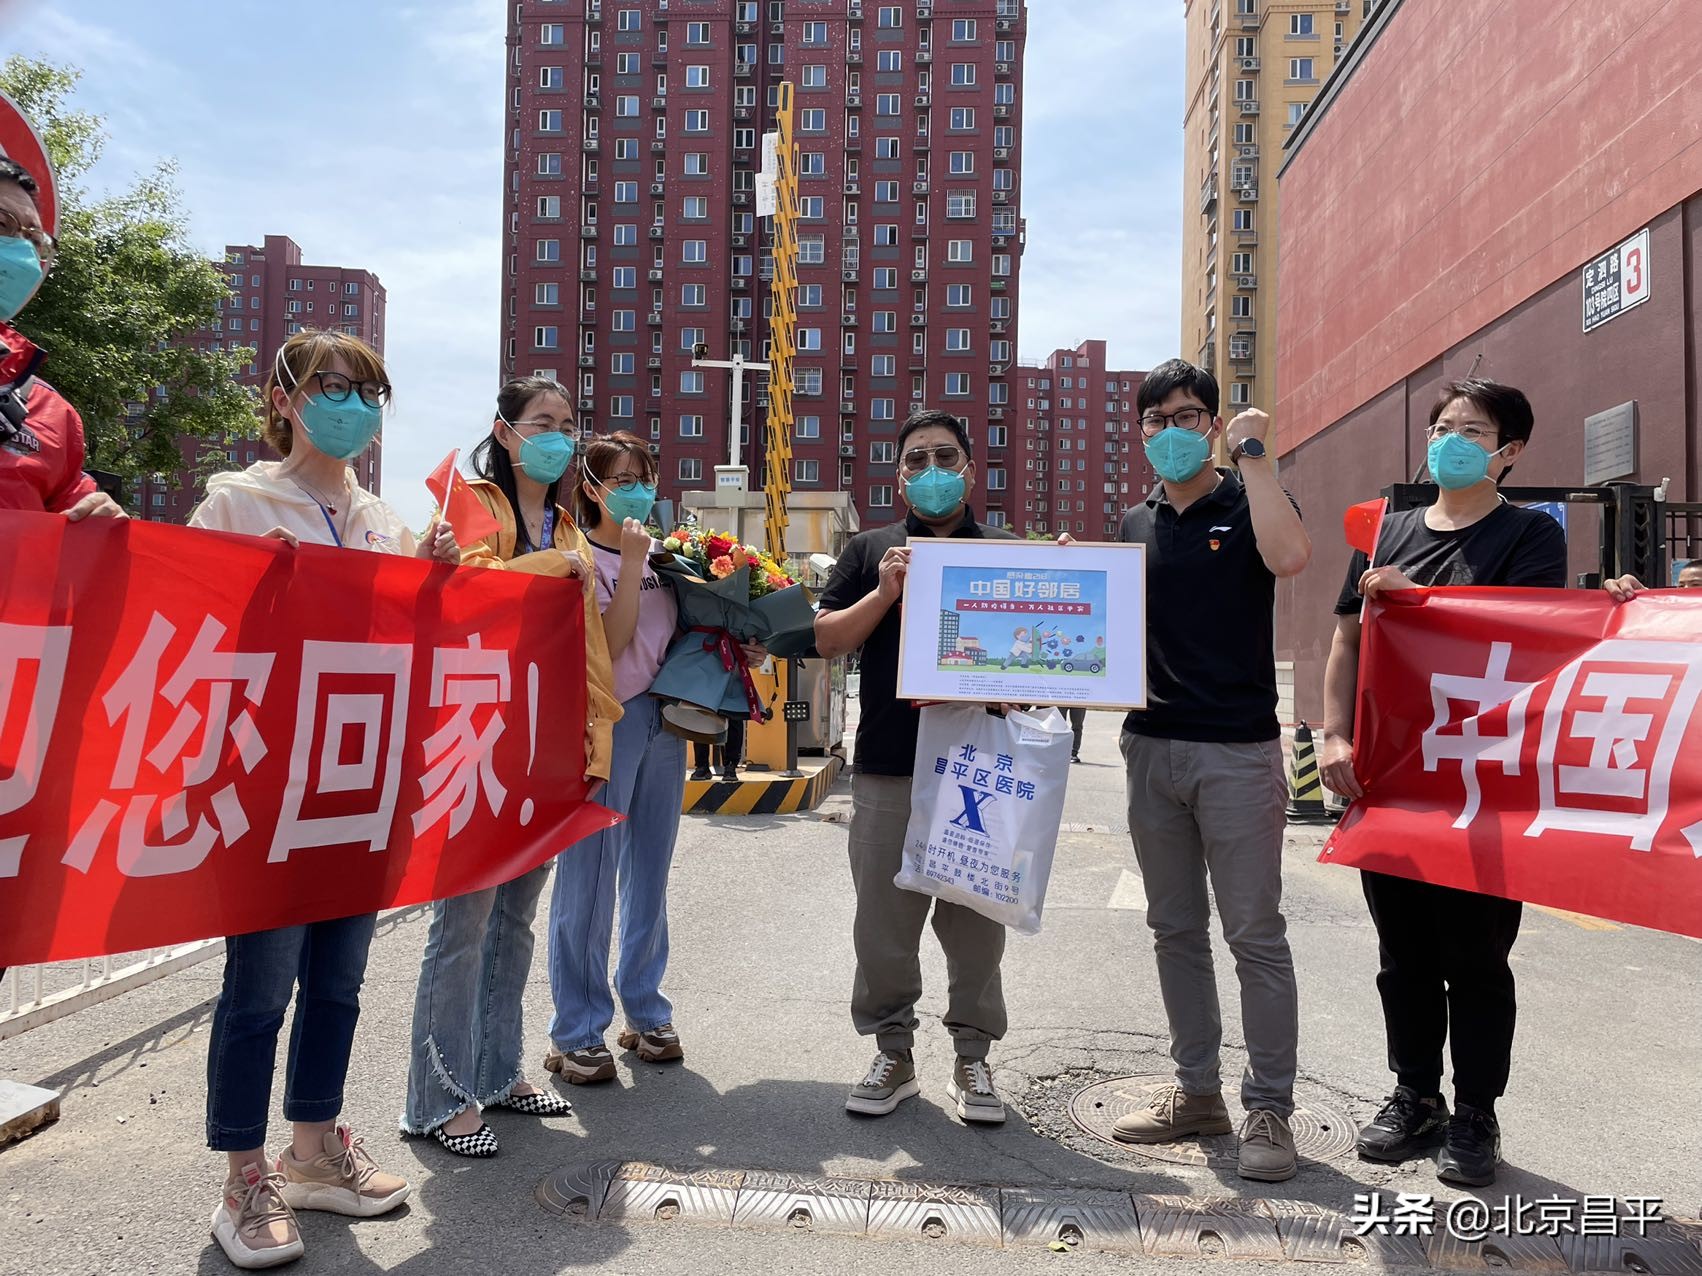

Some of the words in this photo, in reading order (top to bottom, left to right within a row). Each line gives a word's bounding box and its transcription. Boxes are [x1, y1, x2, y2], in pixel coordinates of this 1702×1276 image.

[1586, 253, 1619, 289] 定泗路
[1626, 247, 1641, 295] 3
[969, 579, 1081, 600] 中国好邻居
[959, 744, 1013, 773] 北京
[1421, 639, 1702, 858] 中国
[934, 756, 1036, 801] 昌平区医院
